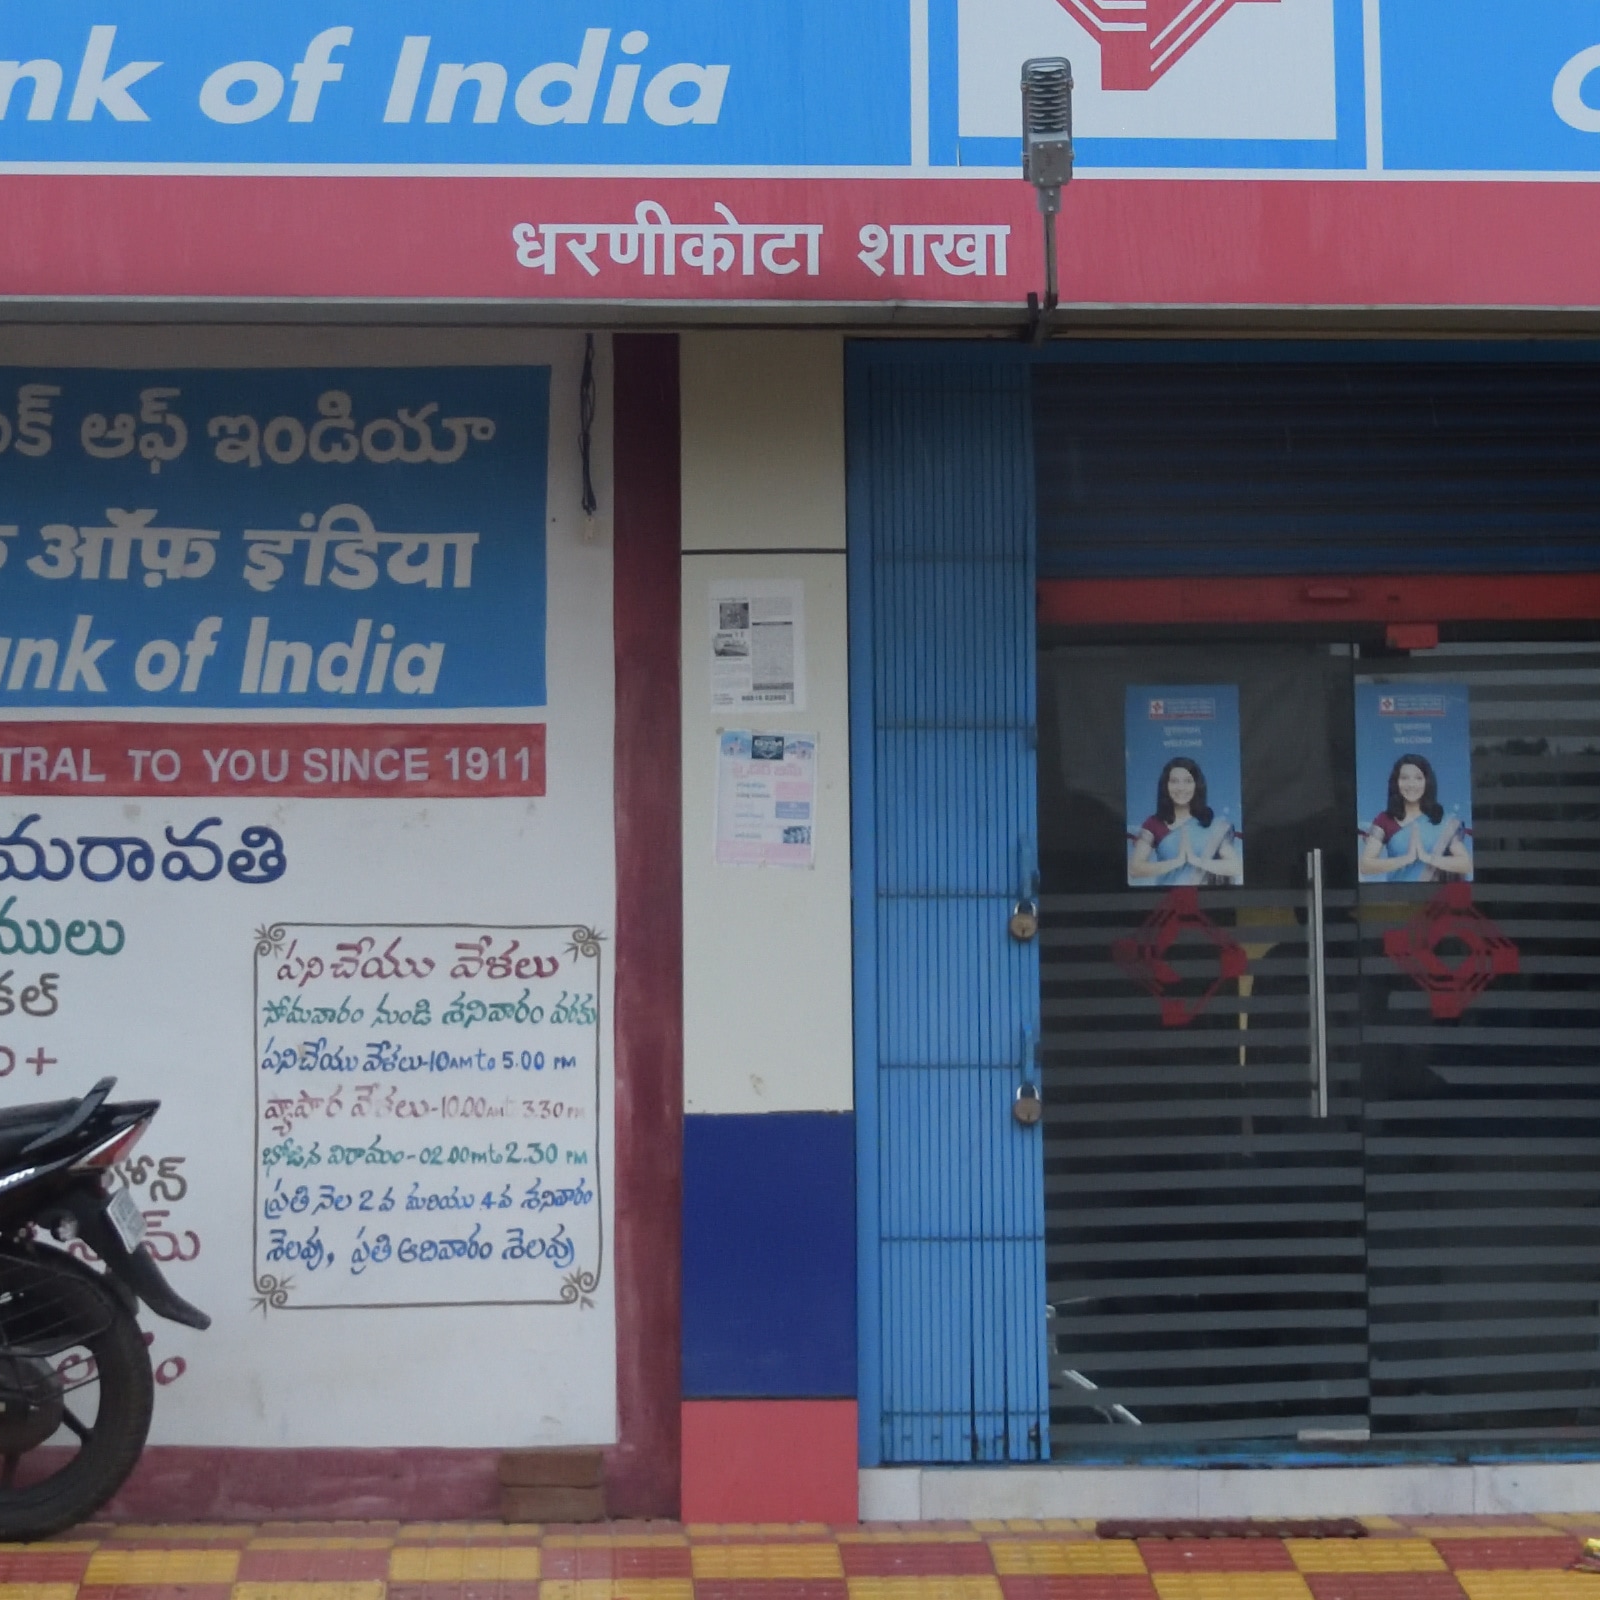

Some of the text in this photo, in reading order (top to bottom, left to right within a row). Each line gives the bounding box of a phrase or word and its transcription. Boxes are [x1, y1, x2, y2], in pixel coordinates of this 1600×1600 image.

[199, 25, 355, 125] of
[383, 29, 731, 128] India
[512, 200, 1011, 278] धरणीकोटा शाखा
[80, 388, 189, 474] ఆఫ్
[207, 390, 496, 467] ఇండియా
[242, 502, 480, 592] इंडिया
[134, 616, 224, 695] of
[239, 616, 446, 696] India
[127, 748, 182, 784] TO
[202, 746, 290, 783] YOU
[302, 746, 430, 783] SINCE
[444, 745, 531, 782] 1911
[502, 1051, 546, 1071] 5.00
[553, 1055, 577, 1070] PM
[505, 1142, 588, 1166] 2.30 PM
